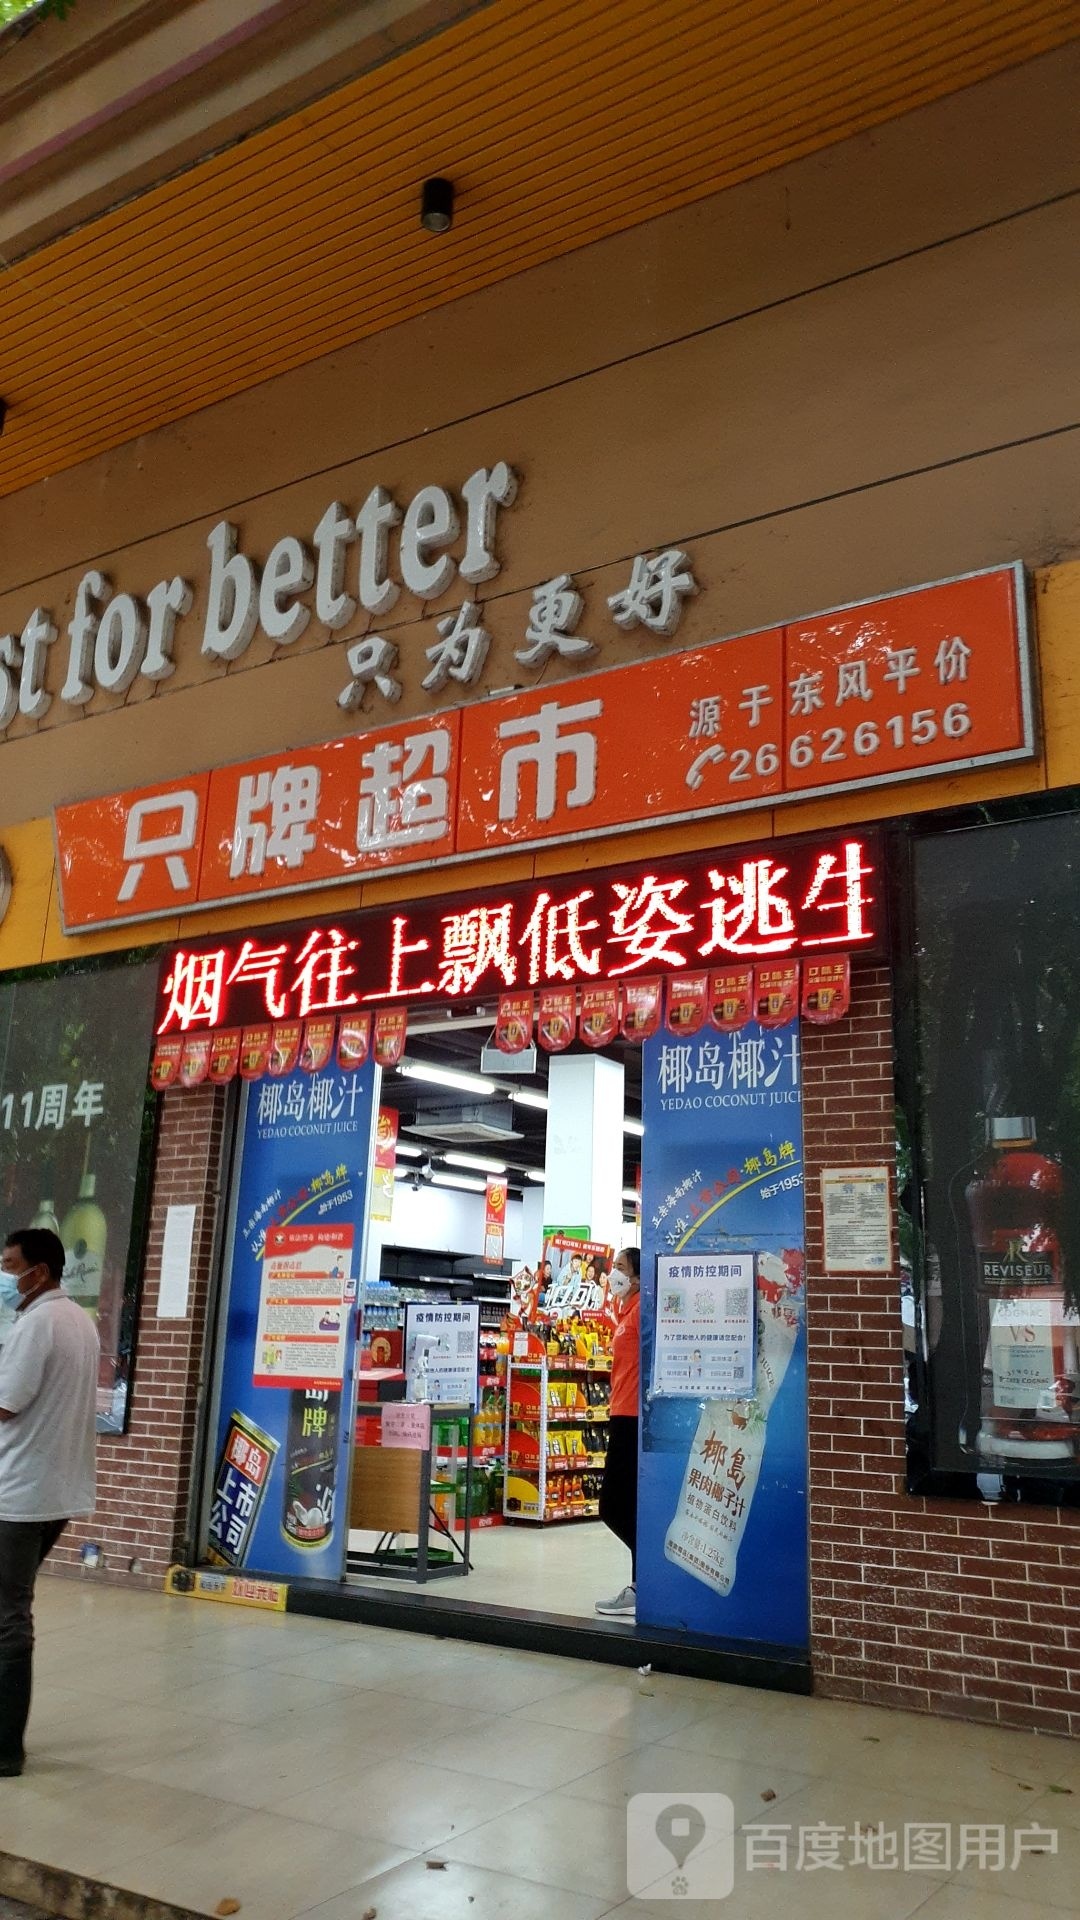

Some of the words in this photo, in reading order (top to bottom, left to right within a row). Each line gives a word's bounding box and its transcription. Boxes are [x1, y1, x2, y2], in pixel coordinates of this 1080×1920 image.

[61, 570, 192, 705] for
[201, 461, 518, 661] better
[337, 549, 699, 710] 只为更好
[689, 634, 973, 740] 源于东风平价
[728, 701, 972, 784] 26626156
[117, 698, 604, 903] 只牌超市
[157, 841, 874, 1035] 烟气往上飘低姿逃生
[656, 1030, 800, 1095] 椰岛椰汁
[1, 1080, 105, 1131] 11周年
[257, 1072, 363, 1126] 椰岛椰汁
[660, 1097, 702, 1111] YEDAO
[705, 1092, 767, 1108] COCONUT
[256, 1127, 287, 1140] YEDAO
[288, 1123, 331, 1137] COCONUT
[332, 1120, 358, 1136] JUICE
[668, 1264, 742, 1278] 疫情防控期间
[984, 1264, 1053, 1277] REVISEUR
[416, 1312, 471, 1323] 疫情防控期间
